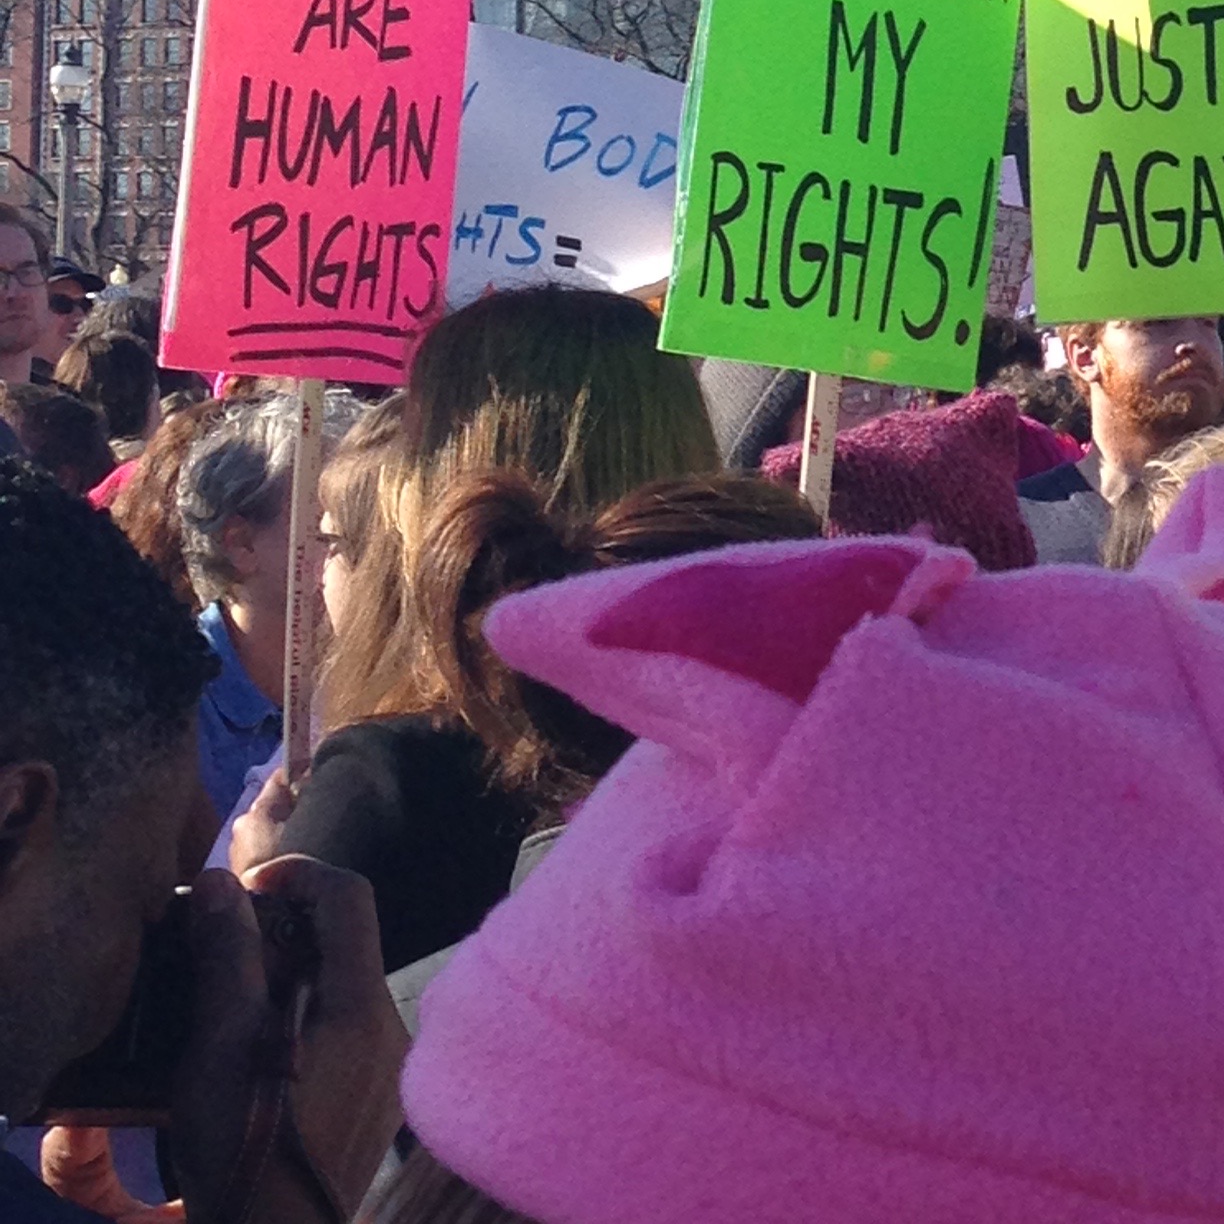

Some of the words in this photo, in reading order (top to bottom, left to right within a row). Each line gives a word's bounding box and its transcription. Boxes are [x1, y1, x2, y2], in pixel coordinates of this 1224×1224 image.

[228, 76, 441, 189] HUMAN
[821, 0, 927, 156] MY
[229, 203, 443, 319] RIGHTS
[698, 148, 995, 347] RIGHTS!
